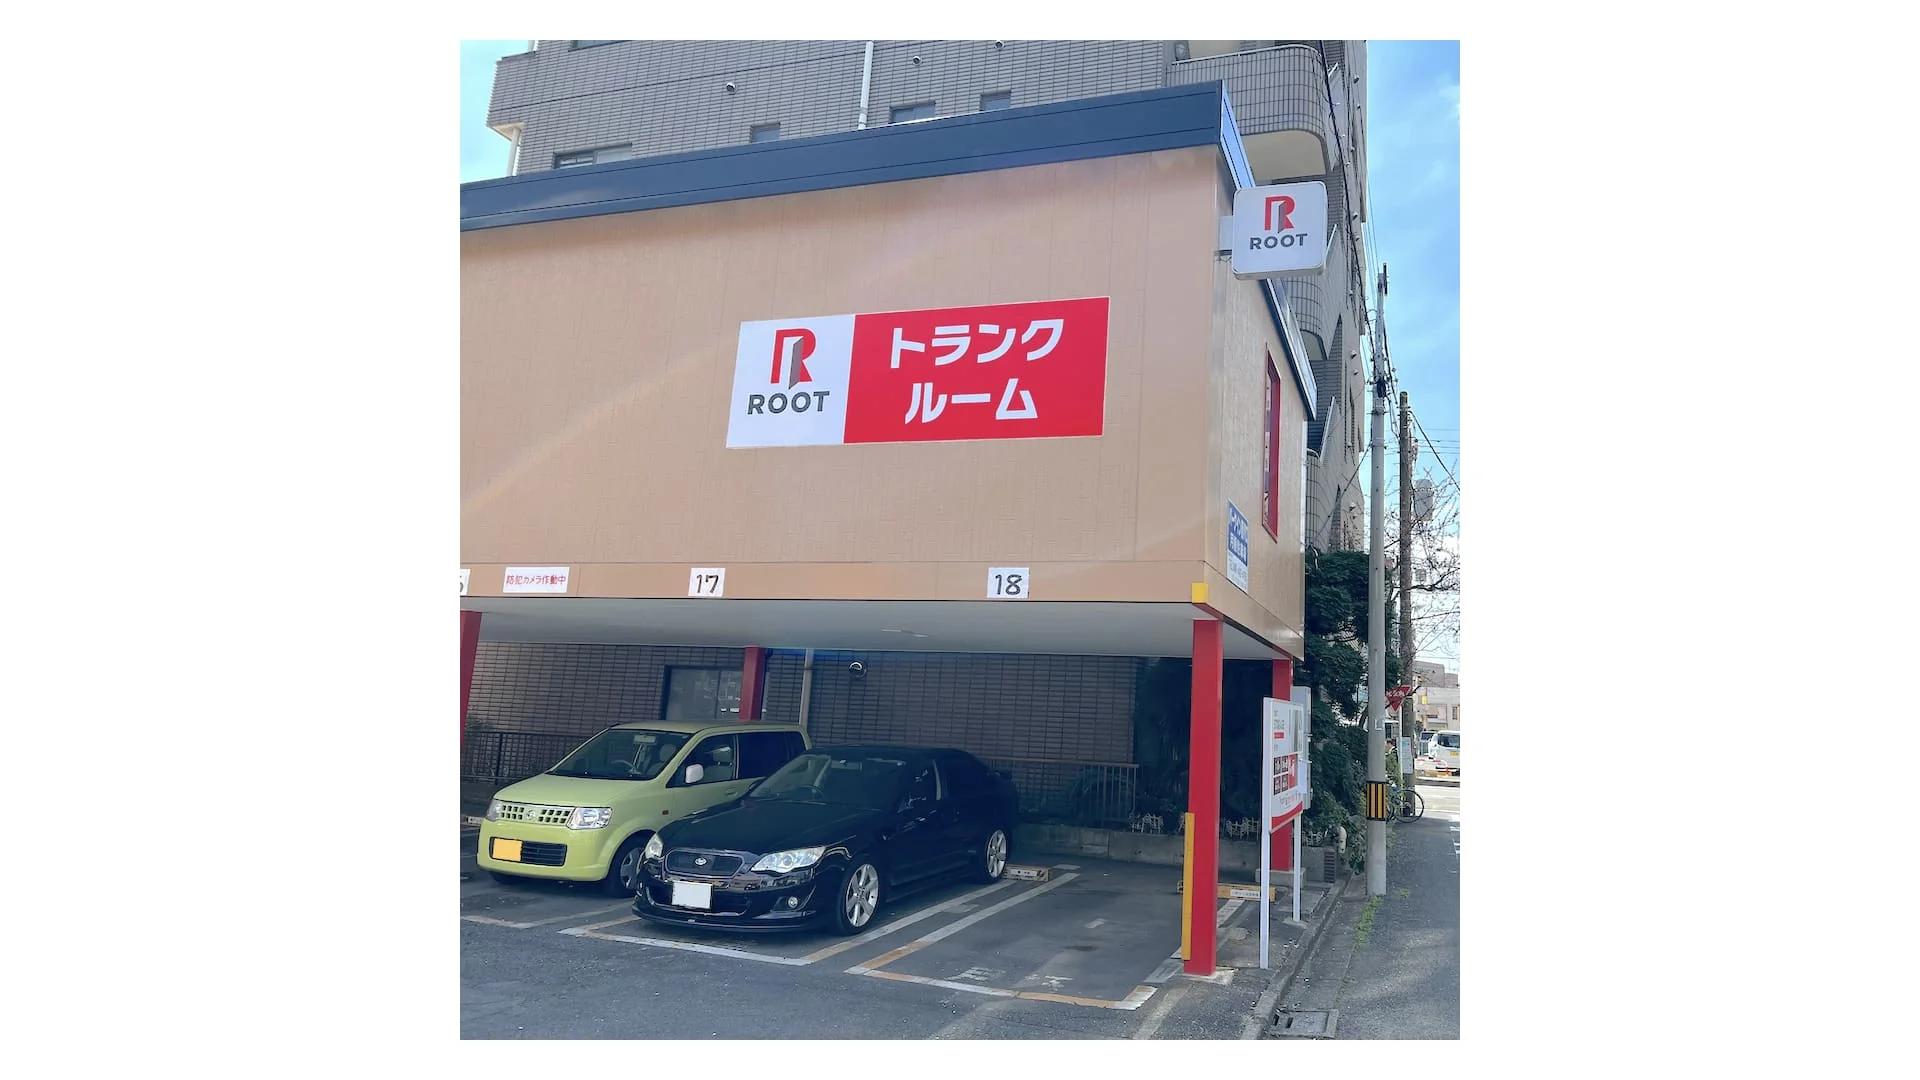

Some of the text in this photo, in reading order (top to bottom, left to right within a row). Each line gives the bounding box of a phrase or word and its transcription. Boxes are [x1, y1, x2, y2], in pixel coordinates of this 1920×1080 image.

[1249, 233, 1308, 250] ROOT
[890, 318, 1064, 369] トランク
[747, 390, 830, 415] ROOT
[904, 378, 1039, 424] ルーム
[506, 575, 567, 584] 防犯カメラ作動中
[696, 574, 719, 594] 17
[995, 574, 1022, 595] 18
